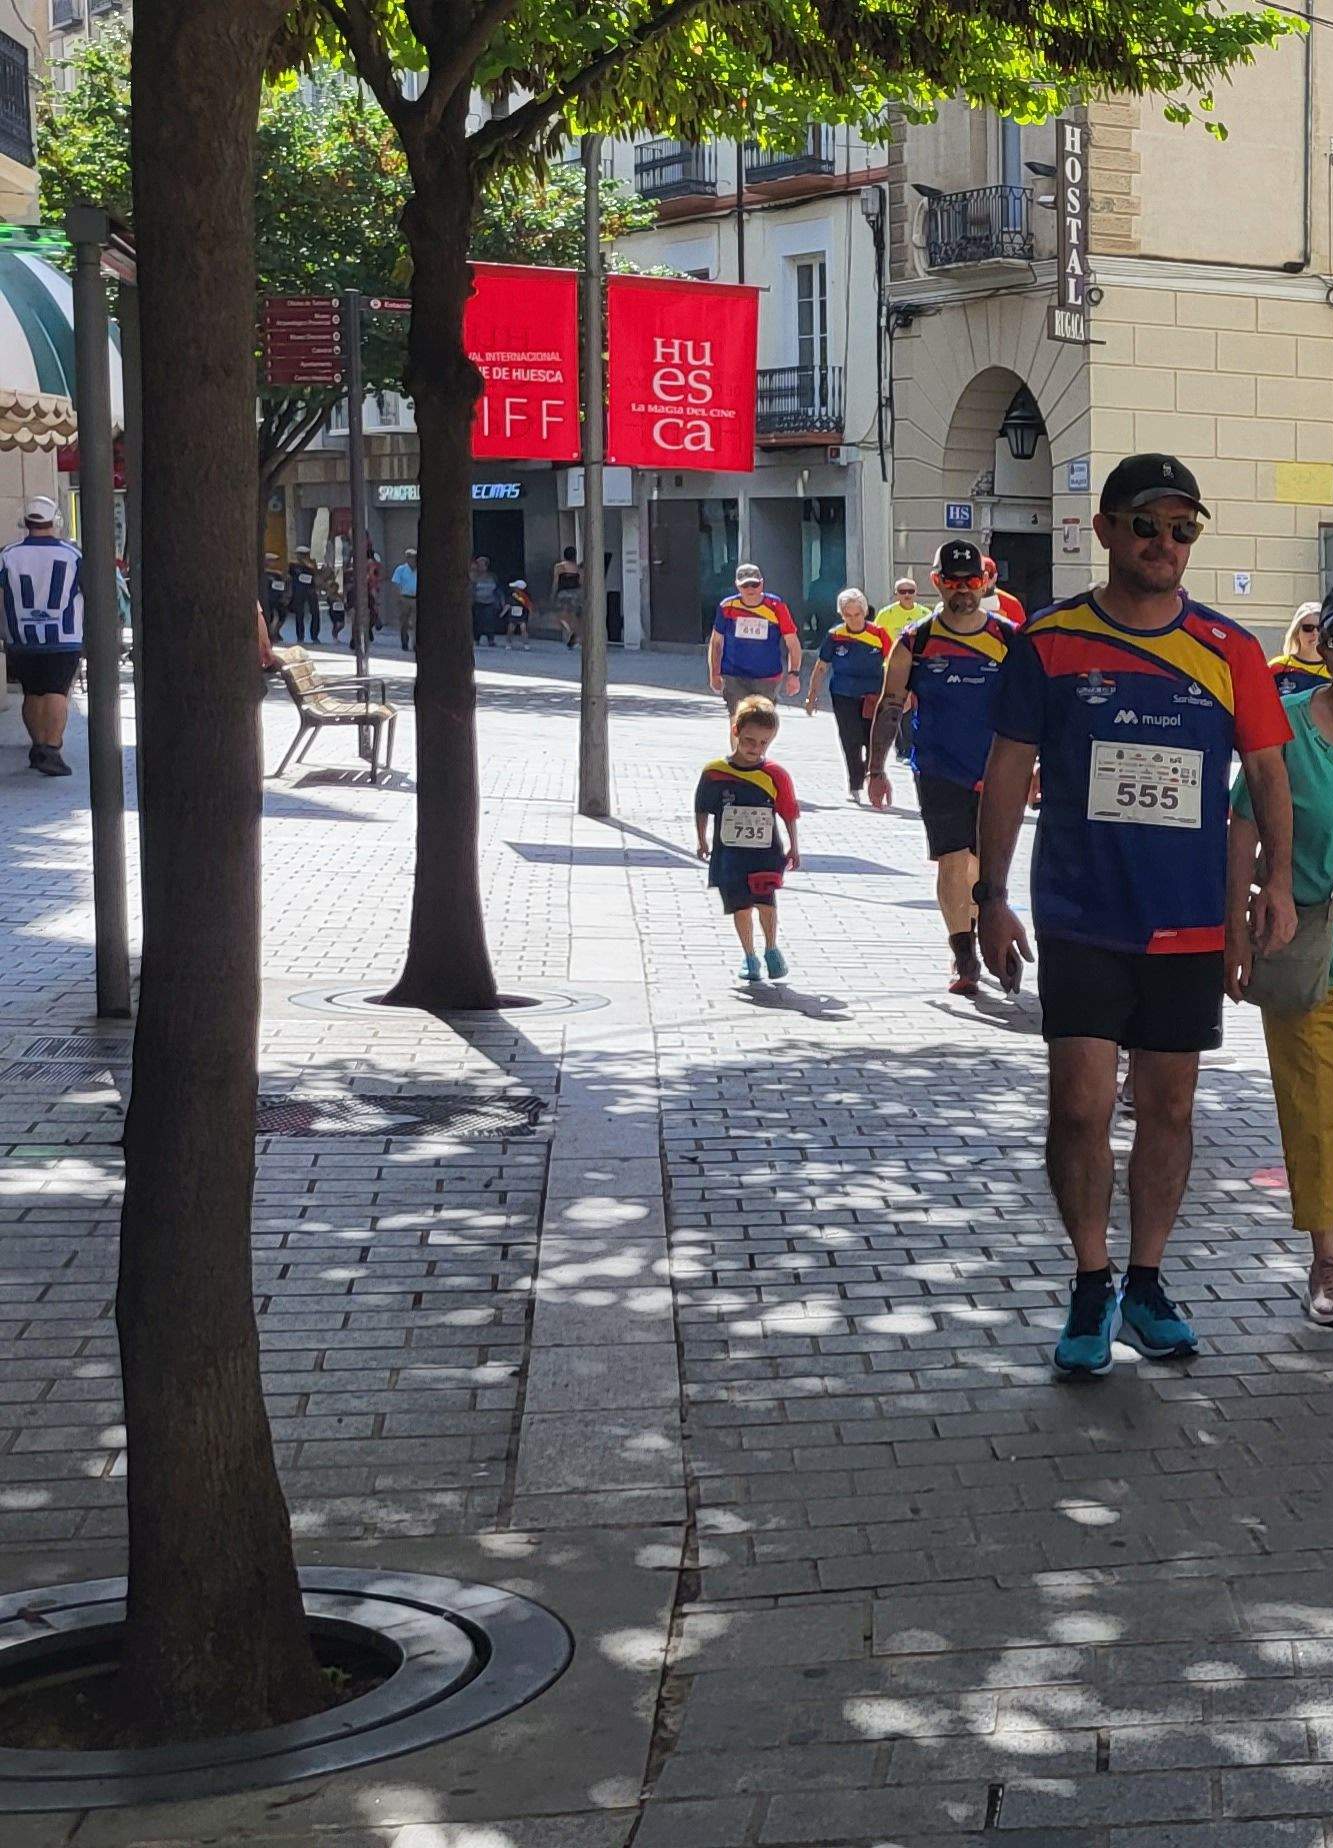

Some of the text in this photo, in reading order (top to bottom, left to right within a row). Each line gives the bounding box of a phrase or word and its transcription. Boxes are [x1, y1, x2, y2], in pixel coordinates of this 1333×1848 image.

[1064, 124, 1084, 306] HOSTAL
[1054, 309, 1085, 341] RUGACA
[485, 352, 562, 362] INTERNACIONAL
[493, 366, 511, 380] DE
[512, 368, 564, 383] HUESCA
[949, 506, 970, 521] HS
[1142, 714, 1181, 727] mupol
[1116, 782, 1179, 810] 555
[734, 825, 765, 840] 735
